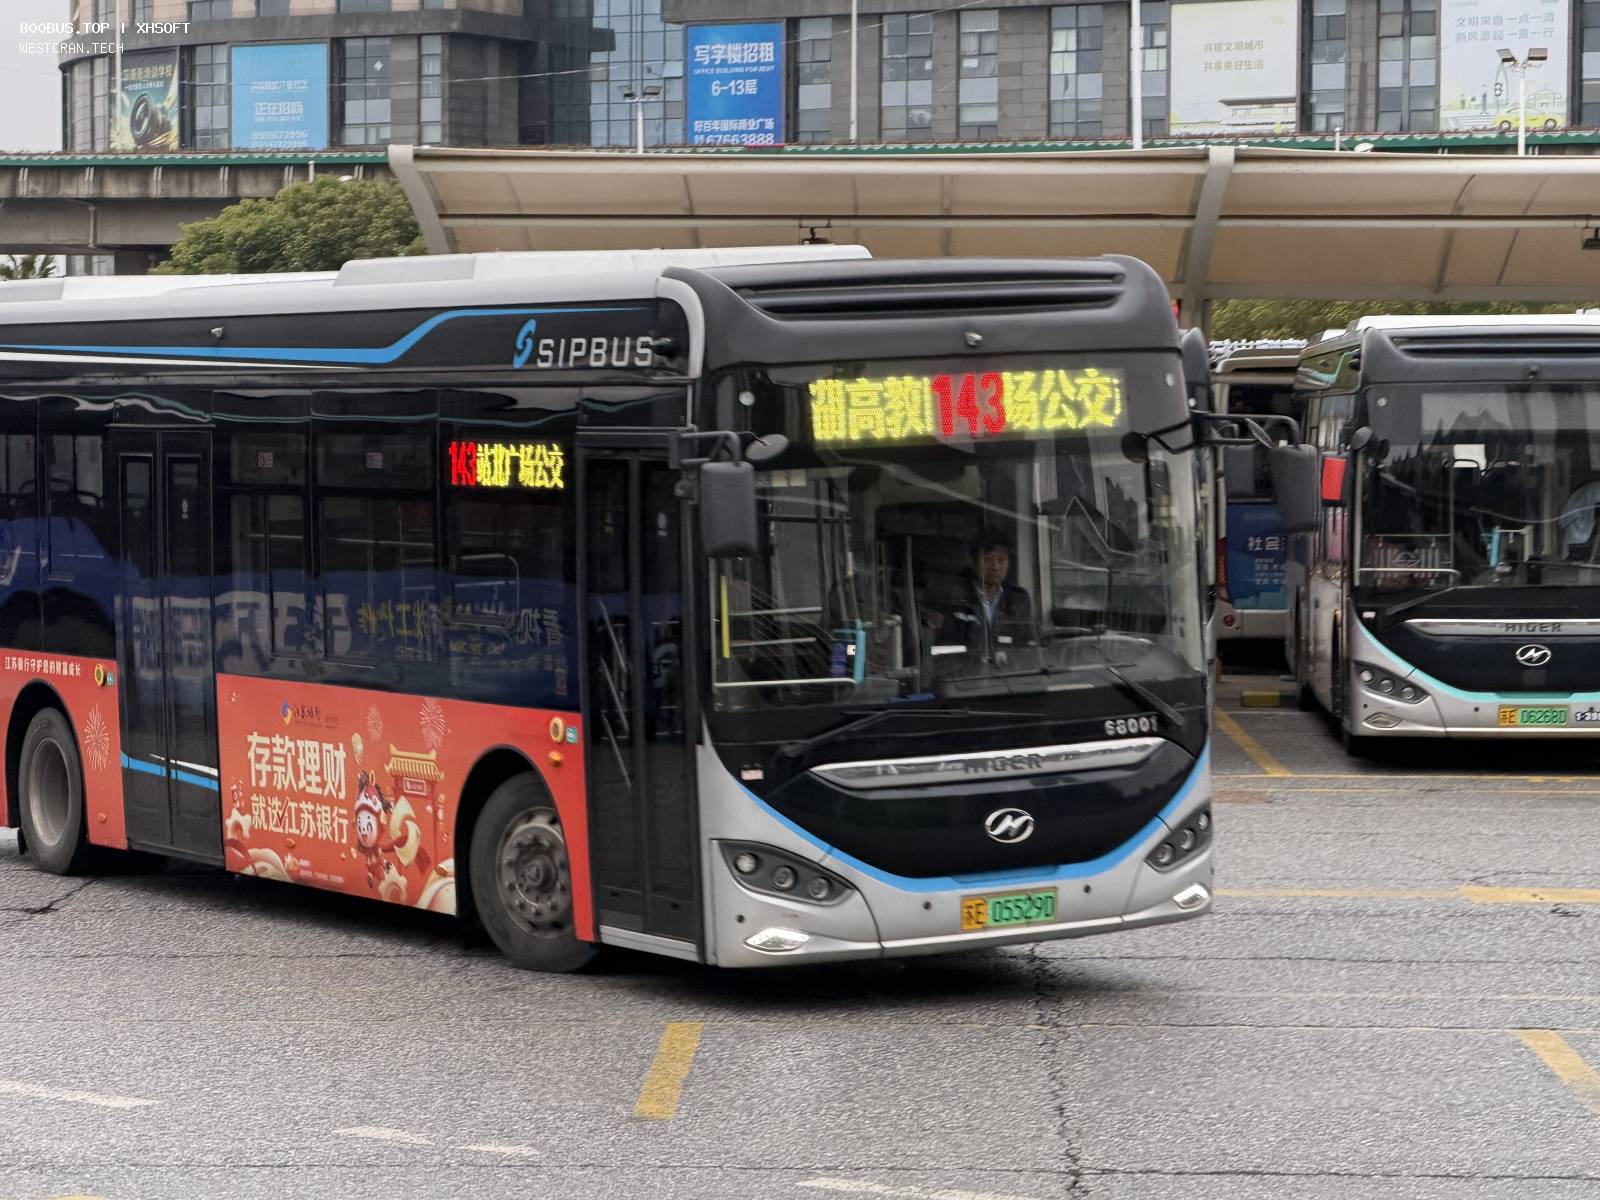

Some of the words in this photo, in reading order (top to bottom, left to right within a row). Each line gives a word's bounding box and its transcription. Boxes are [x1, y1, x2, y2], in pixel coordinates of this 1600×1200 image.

[694, 42, 775, 65] 写字楼招租
[694, 67, 715, 75] OFFICE
[716, 66, 745, 74] BUILDING
[745, 65, 758, 73] FOR
[759, 65, 775, 73] RENT
[711, 79, 758, 96] 6-13层
[537, 336, 653, 368] SIPBUS
[931, 370, 1007, 436] 143
[449, 441, 477, 487] 143
[1505, 622, 1562, 633] HIGER
[247, 731, 347, 800] 存款理财
[250, 793, 349, 845] 就选江苏银行
